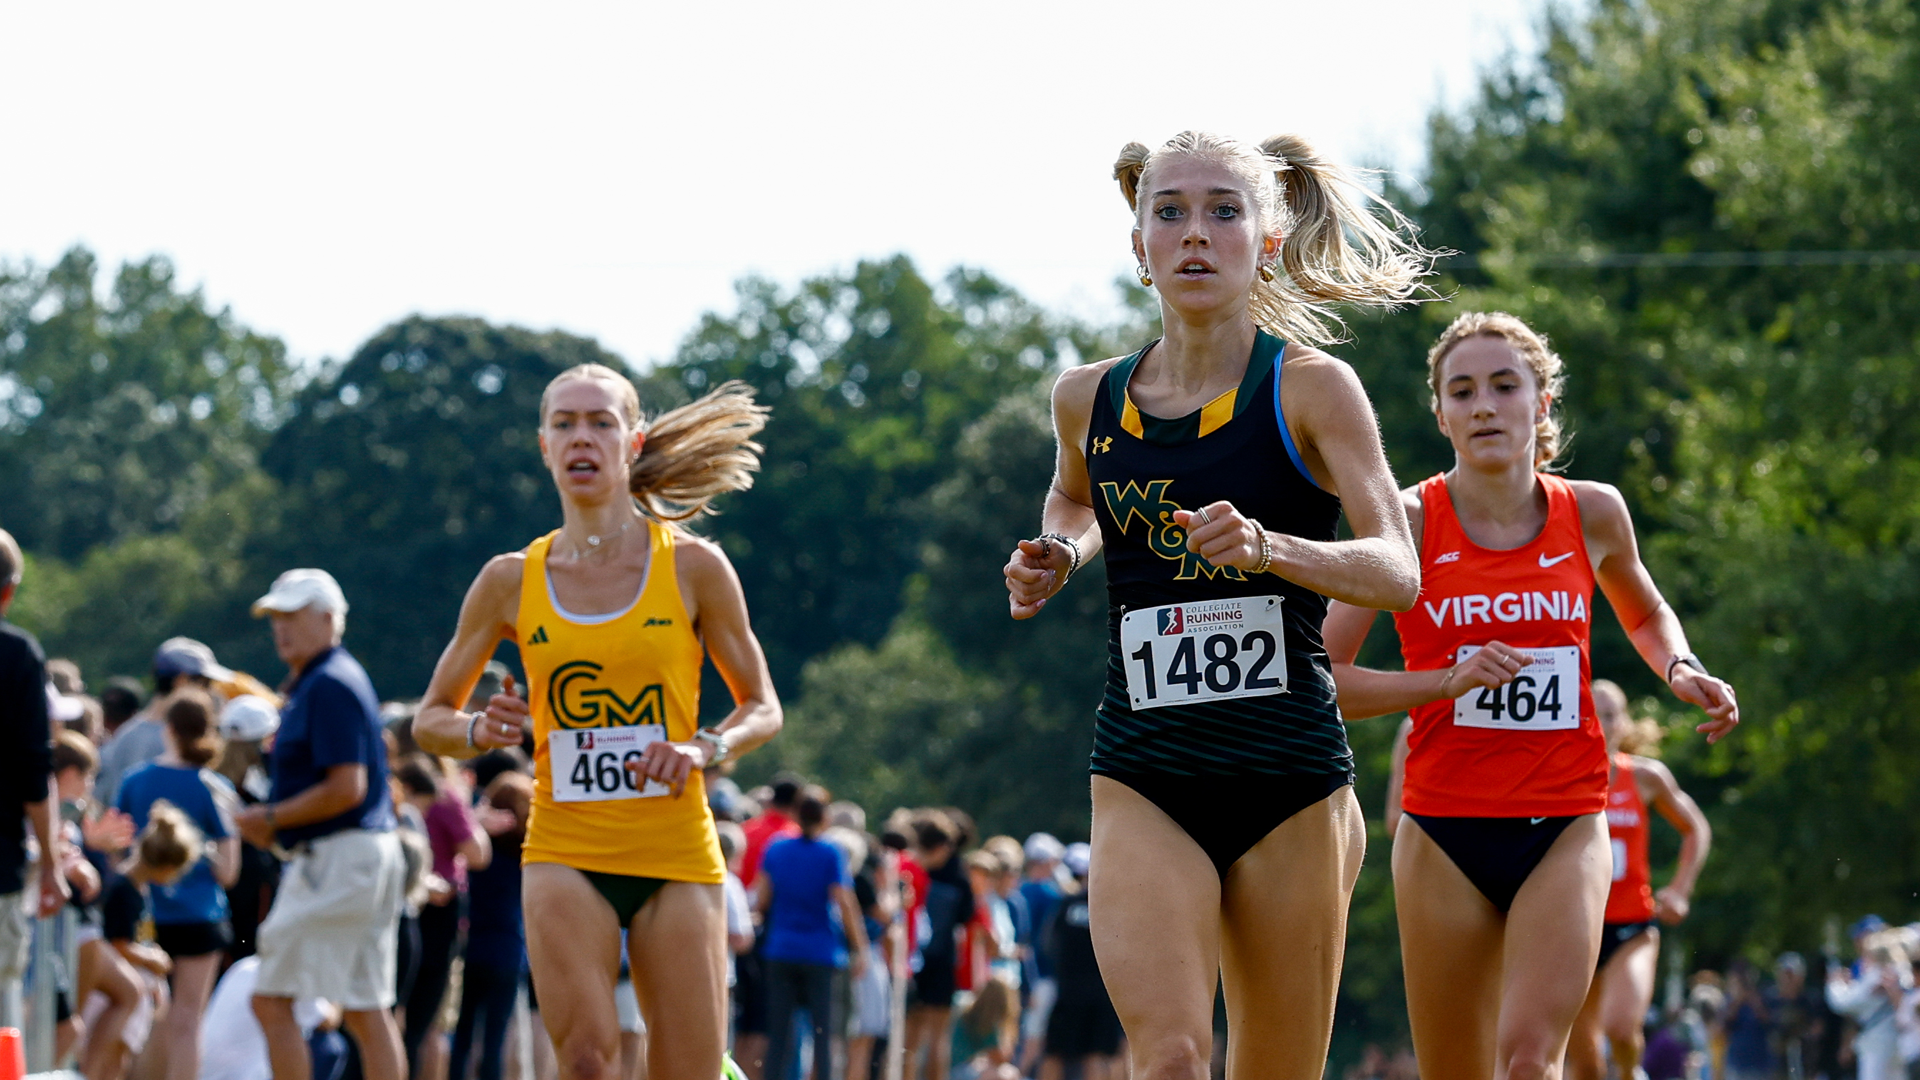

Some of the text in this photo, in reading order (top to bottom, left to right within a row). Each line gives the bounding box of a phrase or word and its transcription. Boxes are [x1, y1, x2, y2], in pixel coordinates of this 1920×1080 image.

[1434, 551, 1460, 564] ACC
[1186, 602, 1242, 613] COLLEGIATE
[1186, 610, 1243, 624] RUNNING
[1424, 590, 1586, 628] VIRGINIA
[1187, 623, 1244, 634] ASSOCIATION
[1131, 630, 1280, 700] 1482
[548, 661, 668, 741] GM
[1476, 674, 1562, 722] 464
